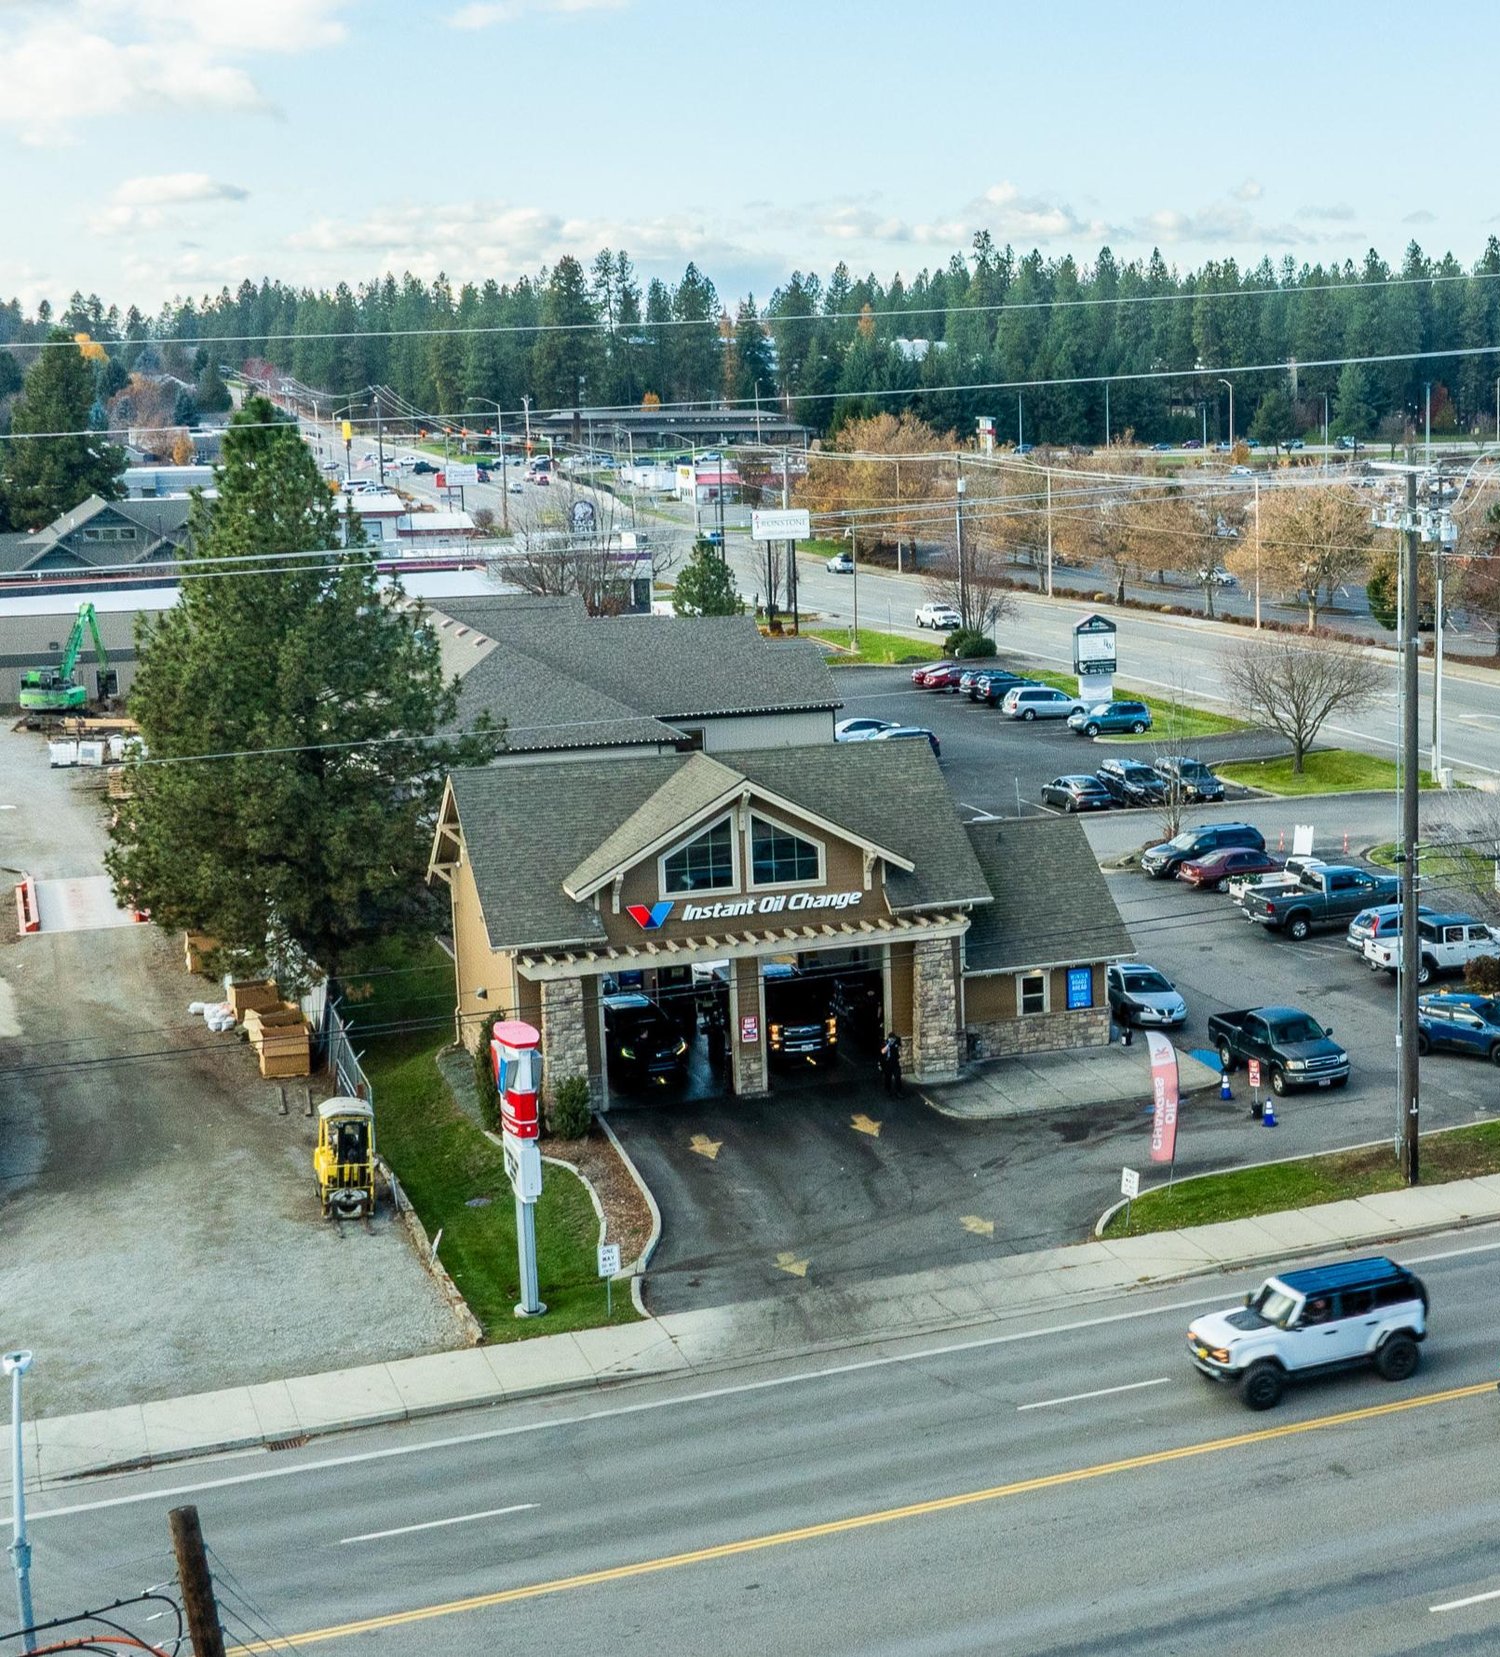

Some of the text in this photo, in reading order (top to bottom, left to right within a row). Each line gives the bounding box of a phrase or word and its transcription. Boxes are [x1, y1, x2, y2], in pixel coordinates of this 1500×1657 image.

[681, 891, 863, 922] Instant Oil Change
